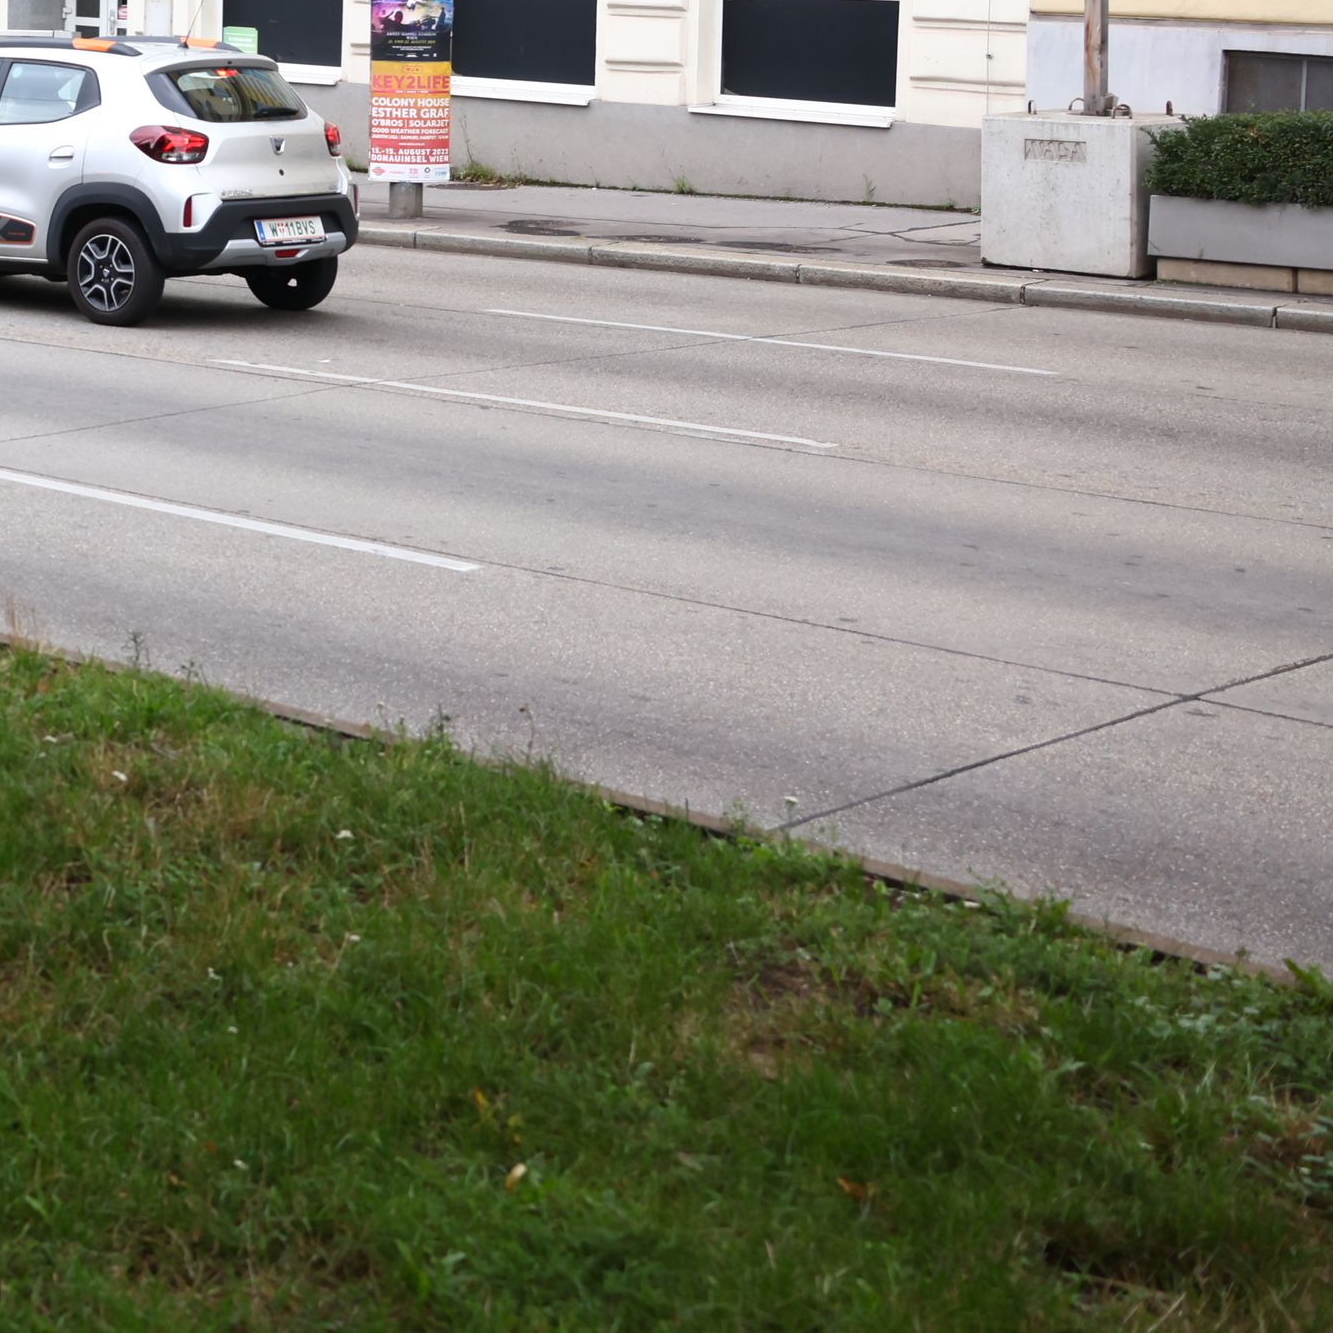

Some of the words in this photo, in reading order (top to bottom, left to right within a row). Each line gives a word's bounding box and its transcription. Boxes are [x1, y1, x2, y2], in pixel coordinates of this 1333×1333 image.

[373, 74, 450, 89] KEY2LIFE
[372, 97, 416, 106] COLONY
[418, 98, 450, 106] HOUSE
[372, 107, 417, 118] ESTHER
[420, 108, 450, 118] GRAF
[372, 119, 403, 127] O'BROS
[371, 154, 427, 162] DONAUINSEL
[269, 222, 278, 237] W
[285, 220, 316, 236] 11BVS
